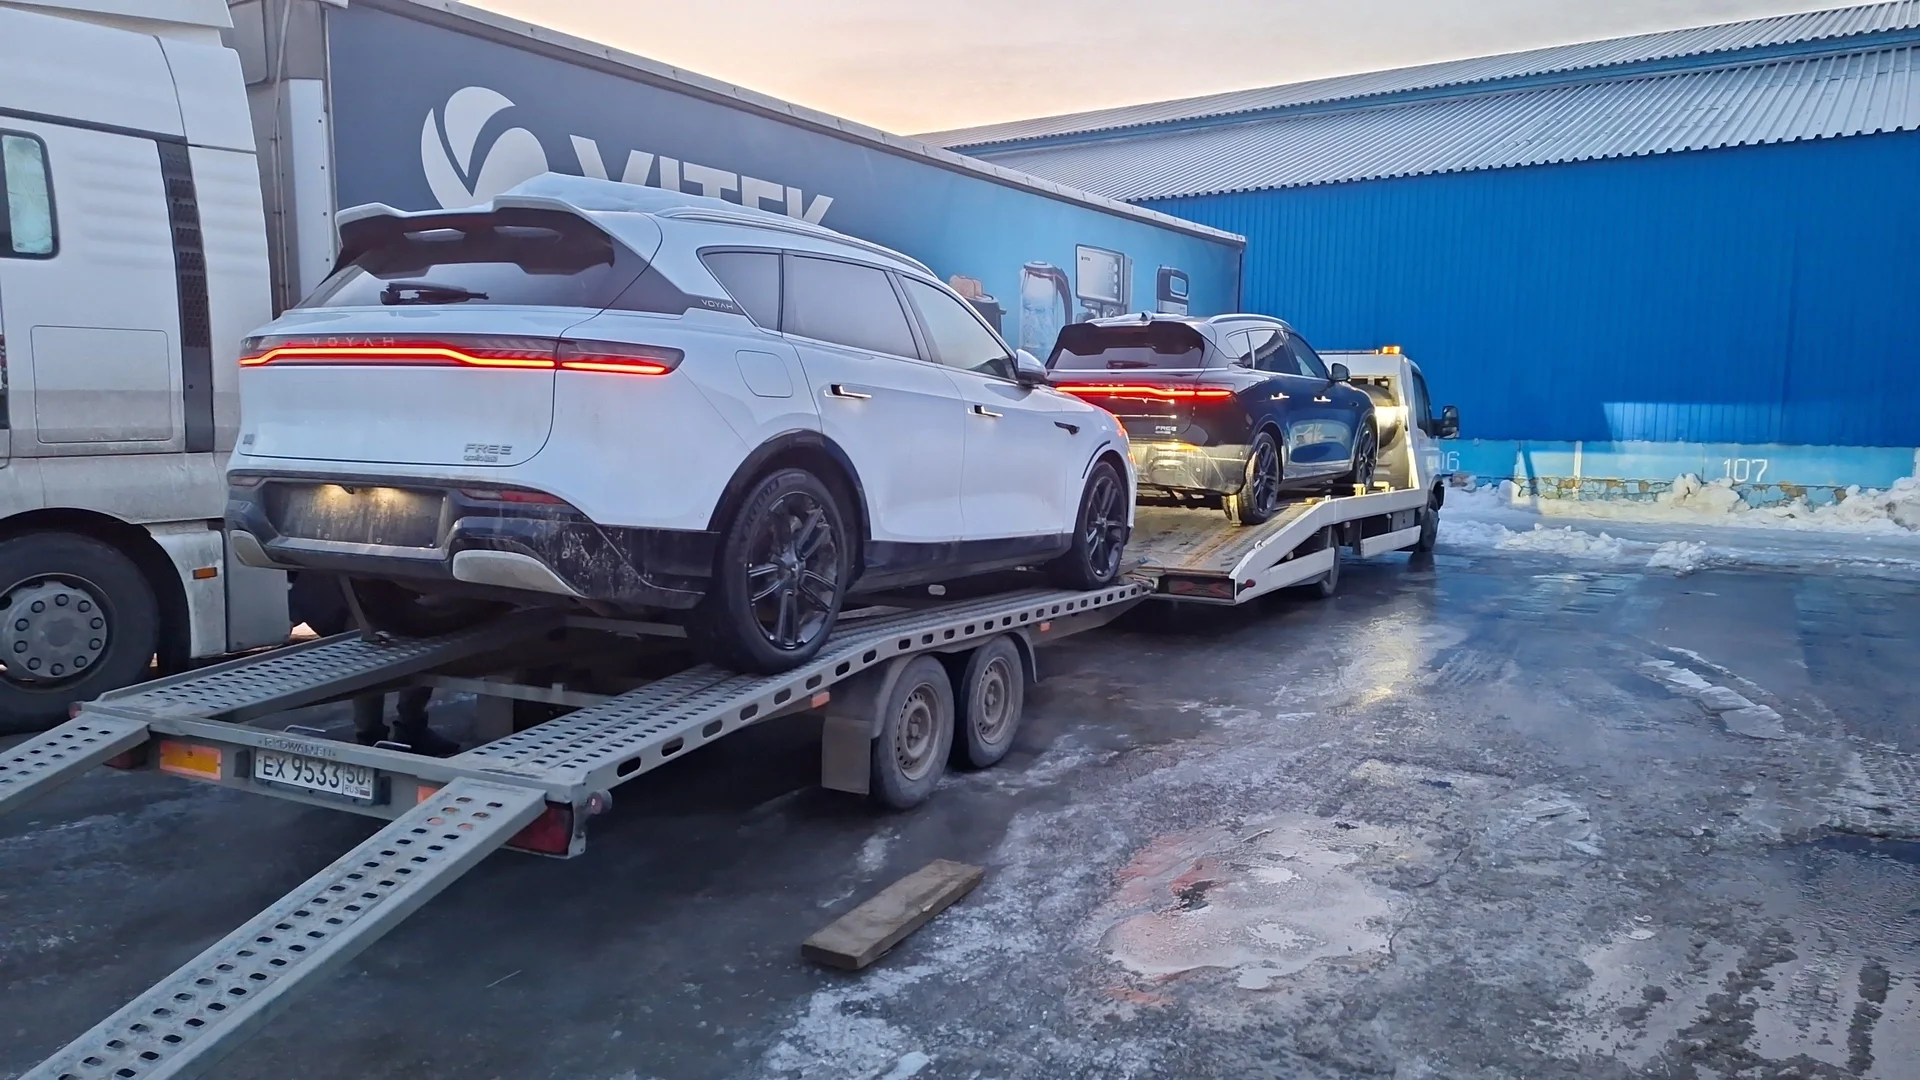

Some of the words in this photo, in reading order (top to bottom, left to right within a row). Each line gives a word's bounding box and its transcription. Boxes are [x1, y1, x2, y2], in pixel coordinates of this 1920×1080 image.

[701, 299, 734, 310] VOYAH
[312, 337, 395, 347] VOYAH
[464, 444, 513, 455] FREE
[1723, 458, 1768, 482] 107
[291, 757, 340, 789] 9533
[346, 765, 366, 786] 50
[344, 785, 359, 794] RUS
